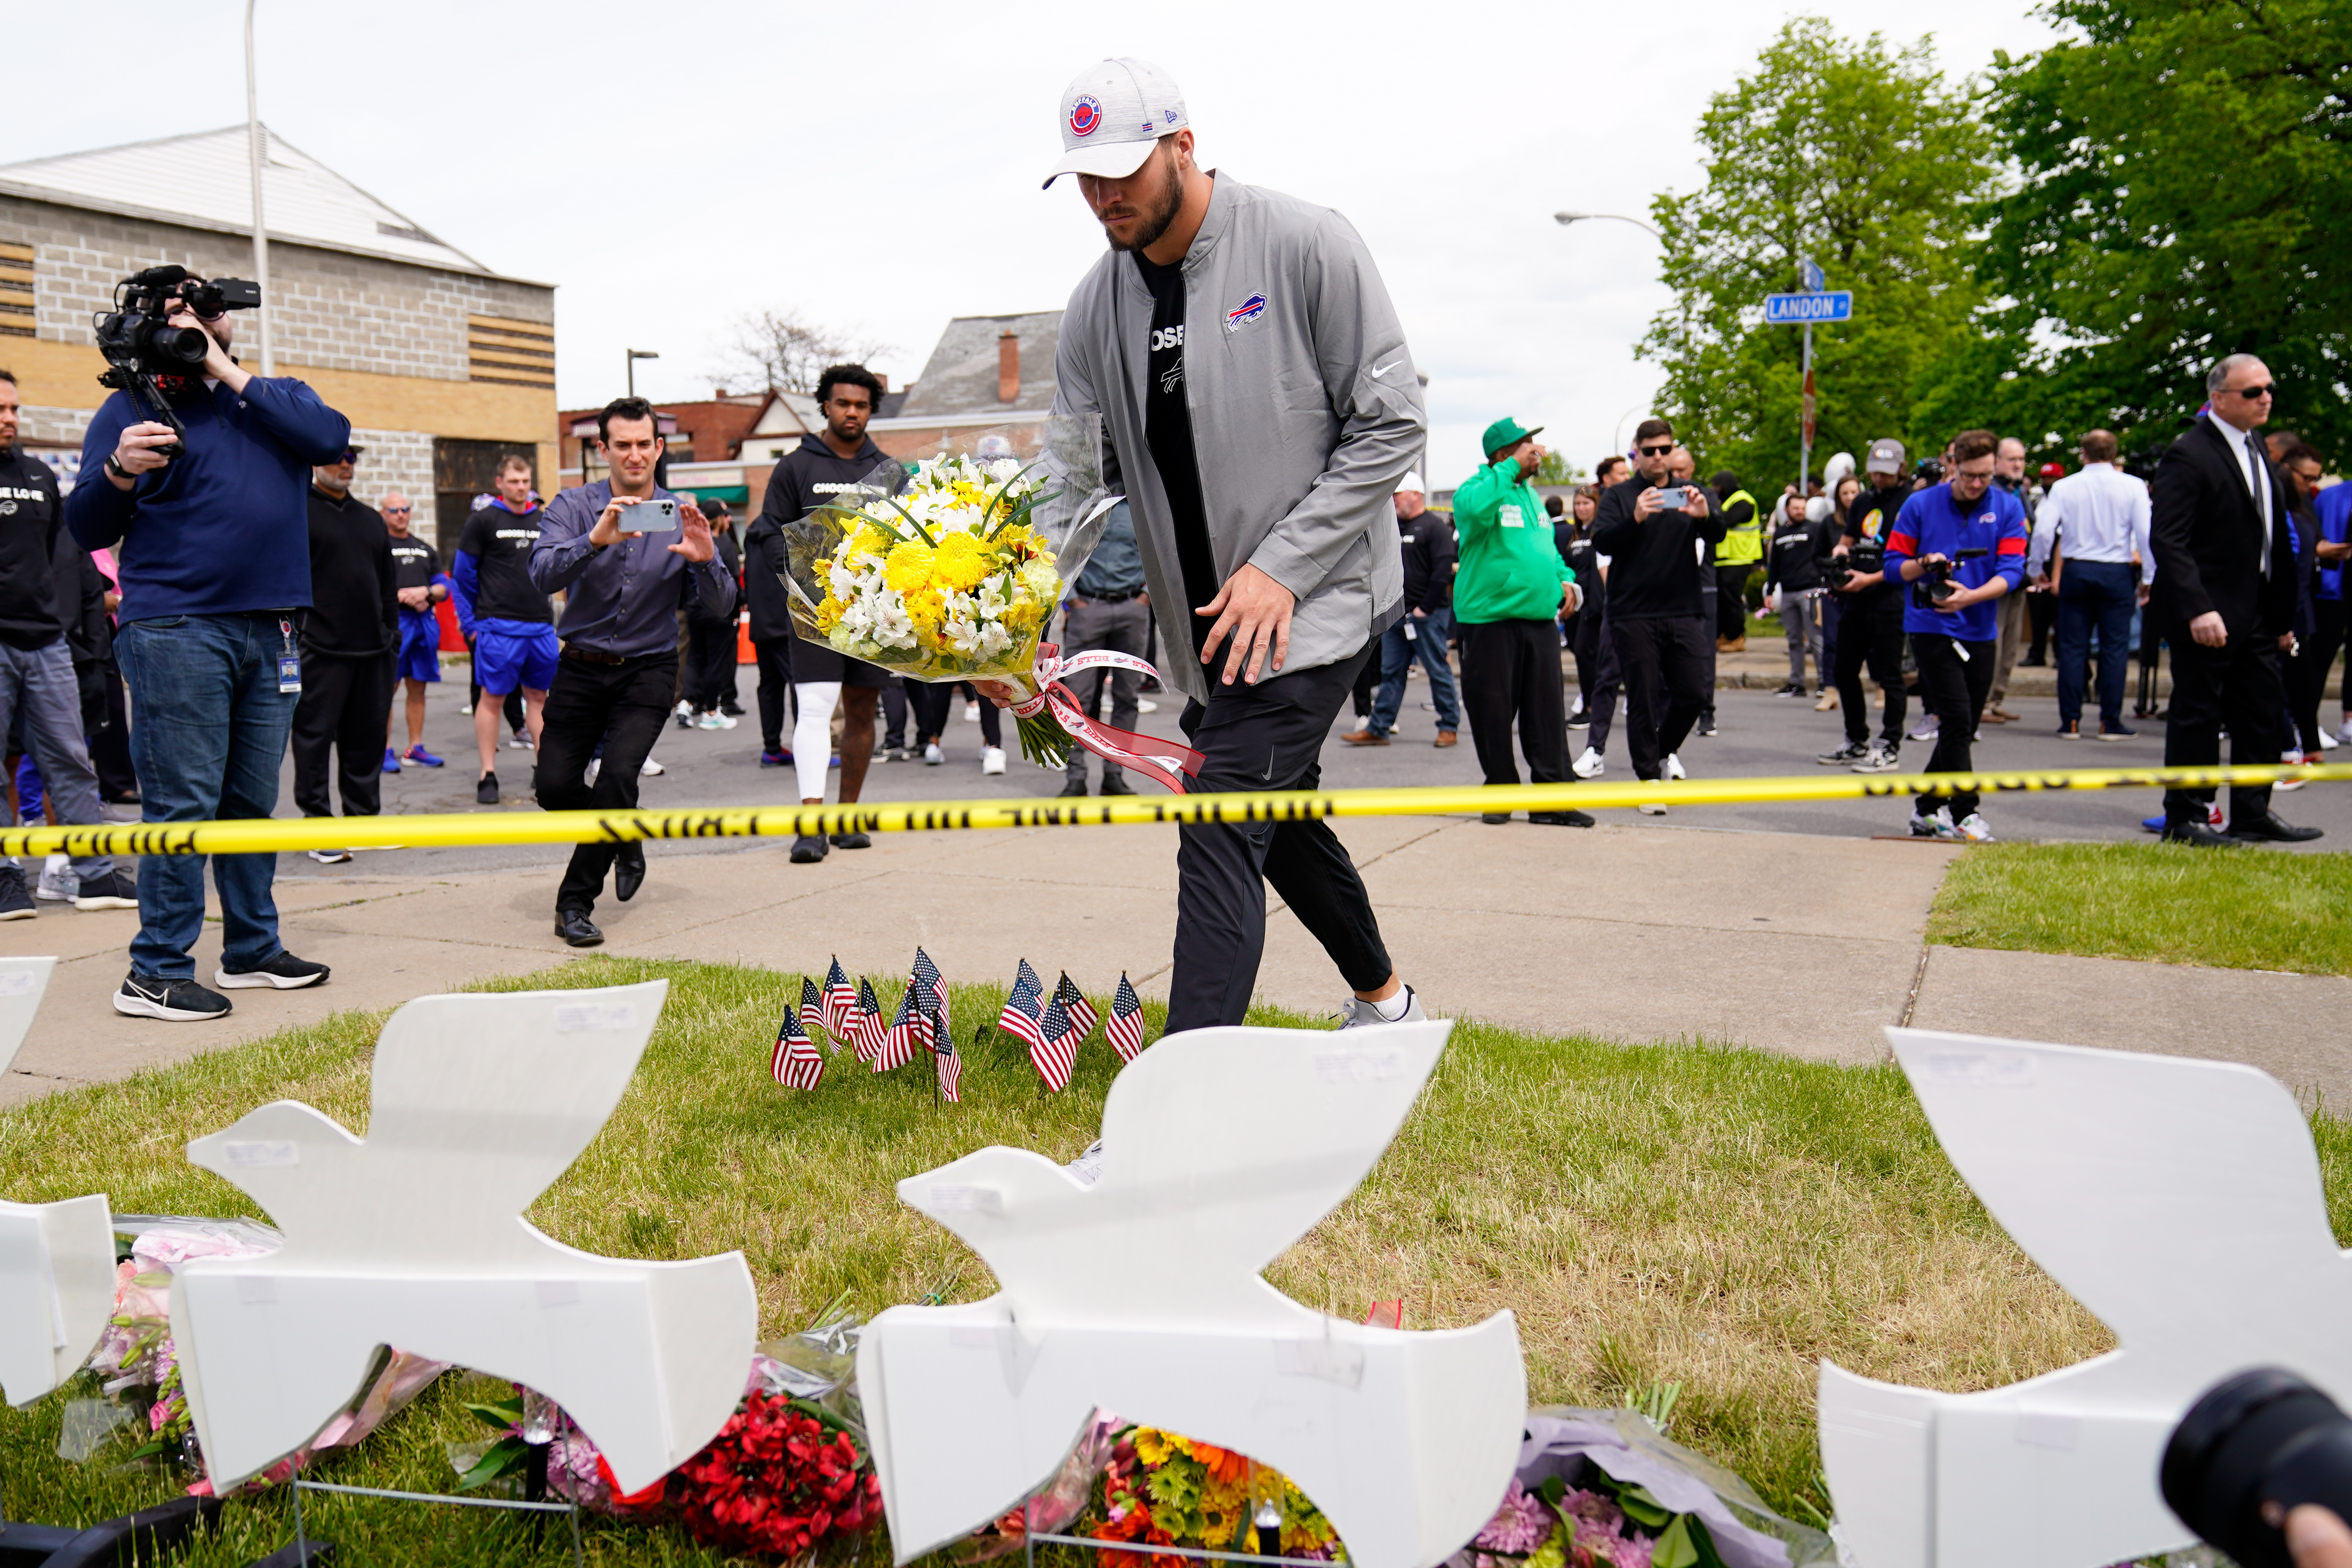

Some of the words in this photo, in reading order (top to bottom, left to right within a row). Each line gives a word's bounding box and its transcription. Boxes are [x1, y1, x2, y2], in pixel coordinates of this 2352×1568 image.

[1071, 96, 1097, 111] BUFFALO
[1769, 296, 1835, 319] LANDON
[812, 482, 858, 495] CHOOSE
[495, 529, 526, 539] CHOOSE
[1078, 656, 1110, 665] BILLS
[1132, 660, 1159, 678] BILLS
[1083, 727, 1111, 749] BILLS
